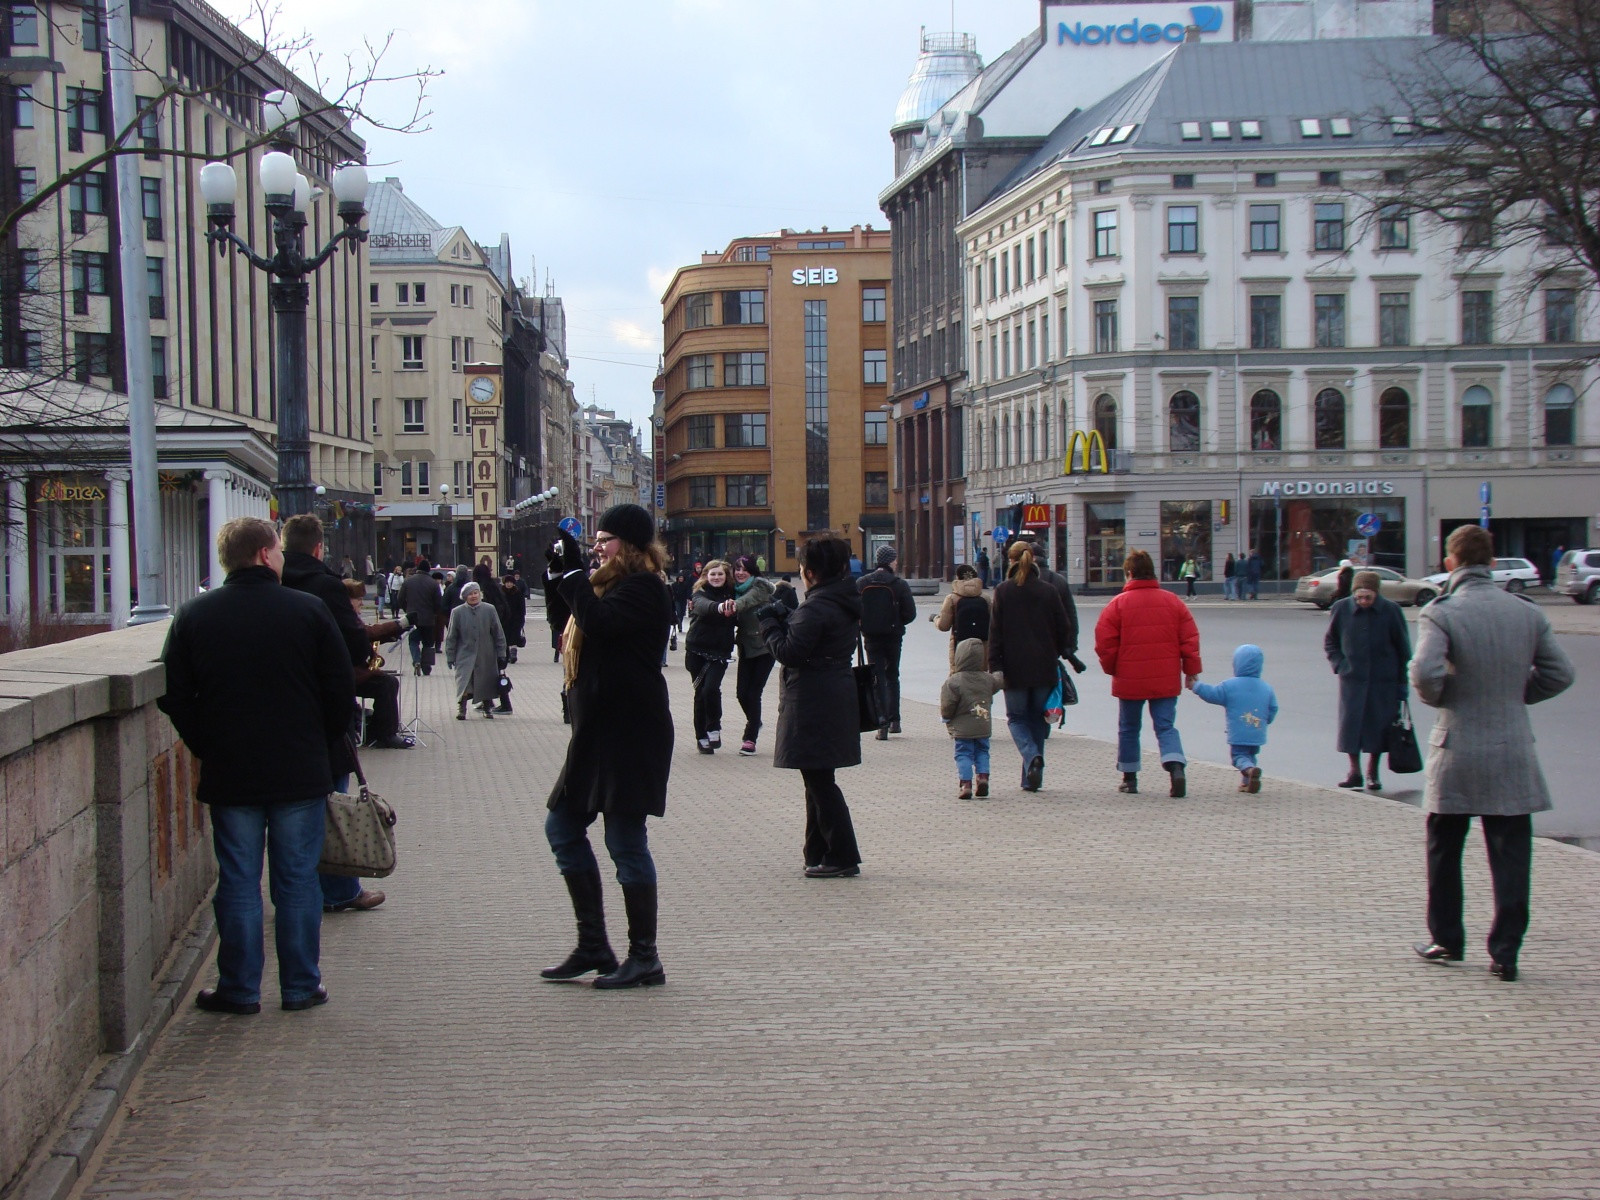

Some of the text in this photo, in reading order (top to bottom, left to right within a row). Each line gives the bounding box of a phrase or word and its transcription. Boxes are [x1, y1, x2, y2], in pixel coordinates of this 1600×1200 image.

[1058, 17, 1186, 45] Nordea
[792, 267, 839, 286] SEB
[65, 486, 105, 501] PICA
[1261, 481, 1394, 495] McDonald's
